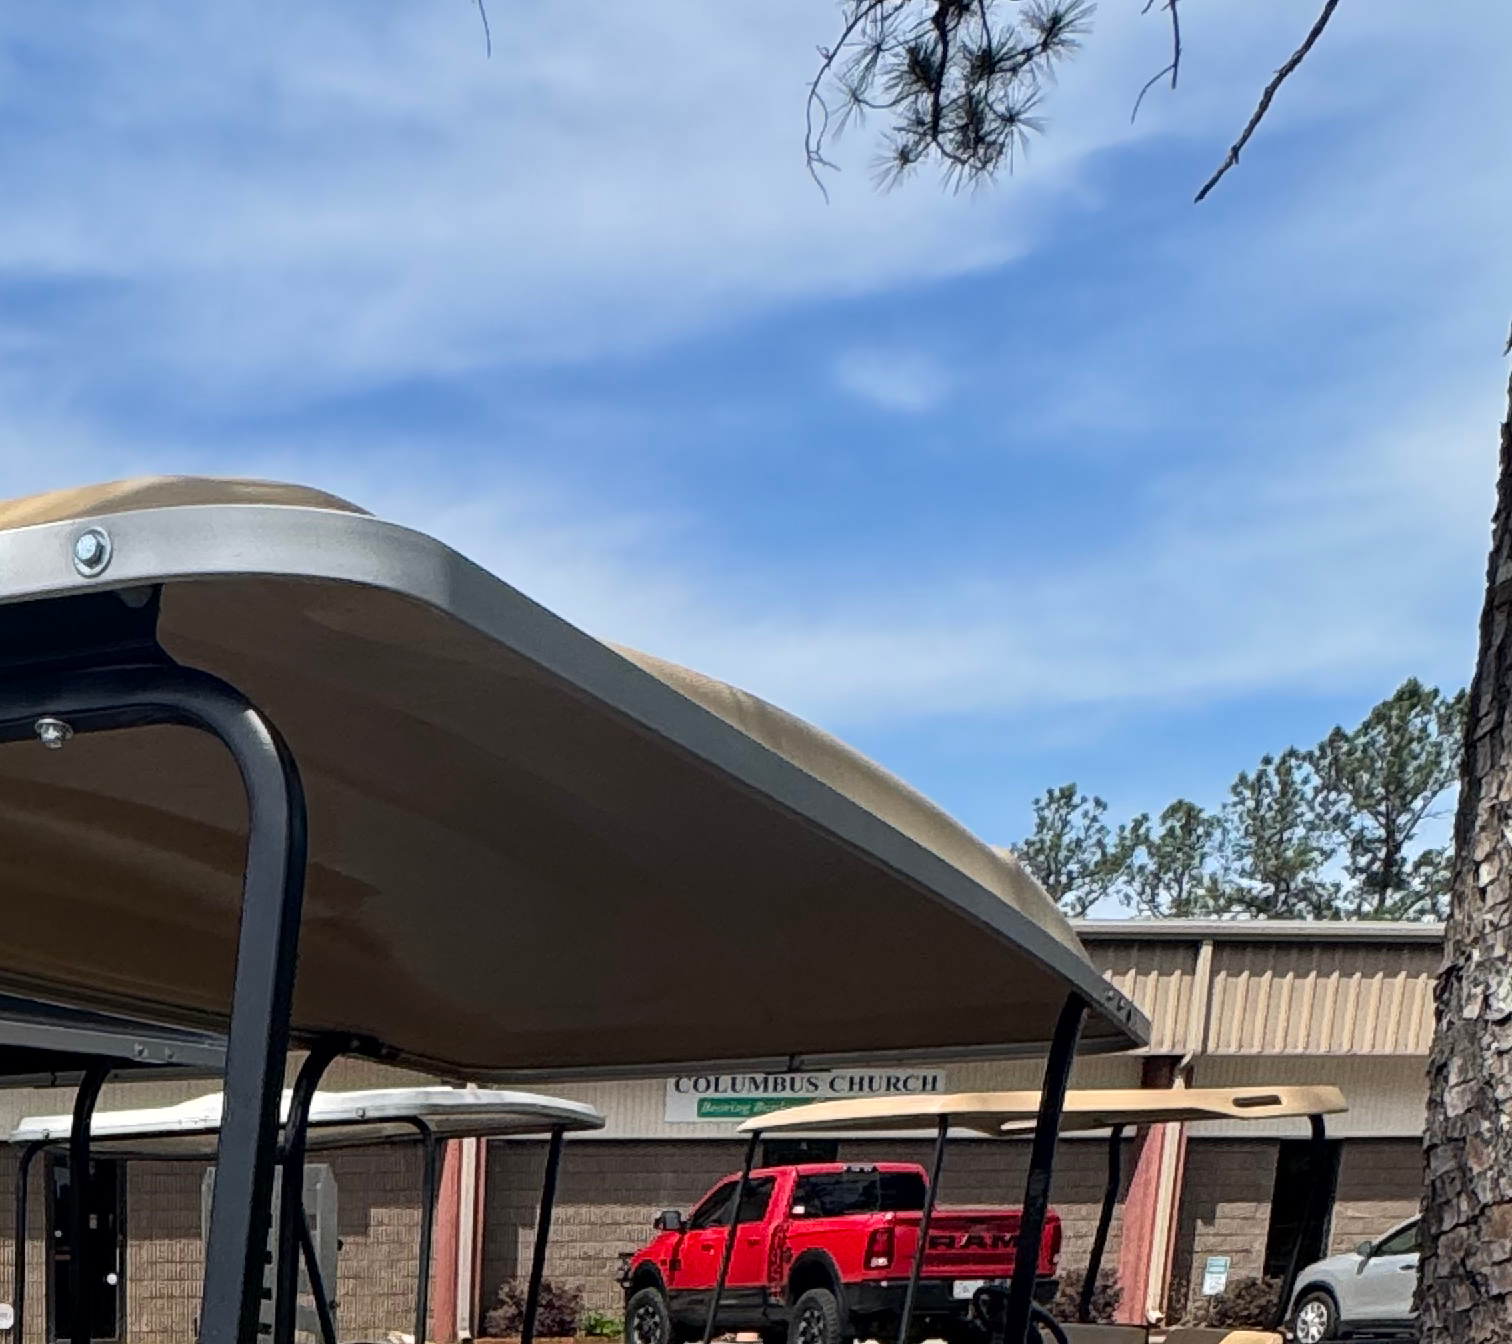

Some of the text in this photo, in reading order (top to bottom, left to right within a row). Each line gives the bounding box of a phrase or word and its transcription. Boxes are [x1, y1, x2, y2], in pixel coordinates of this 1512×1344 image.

[674, 1074, 938, 1094] COLUMBUS CHURCH
[928, 1234, 1019, 1250] RAM
